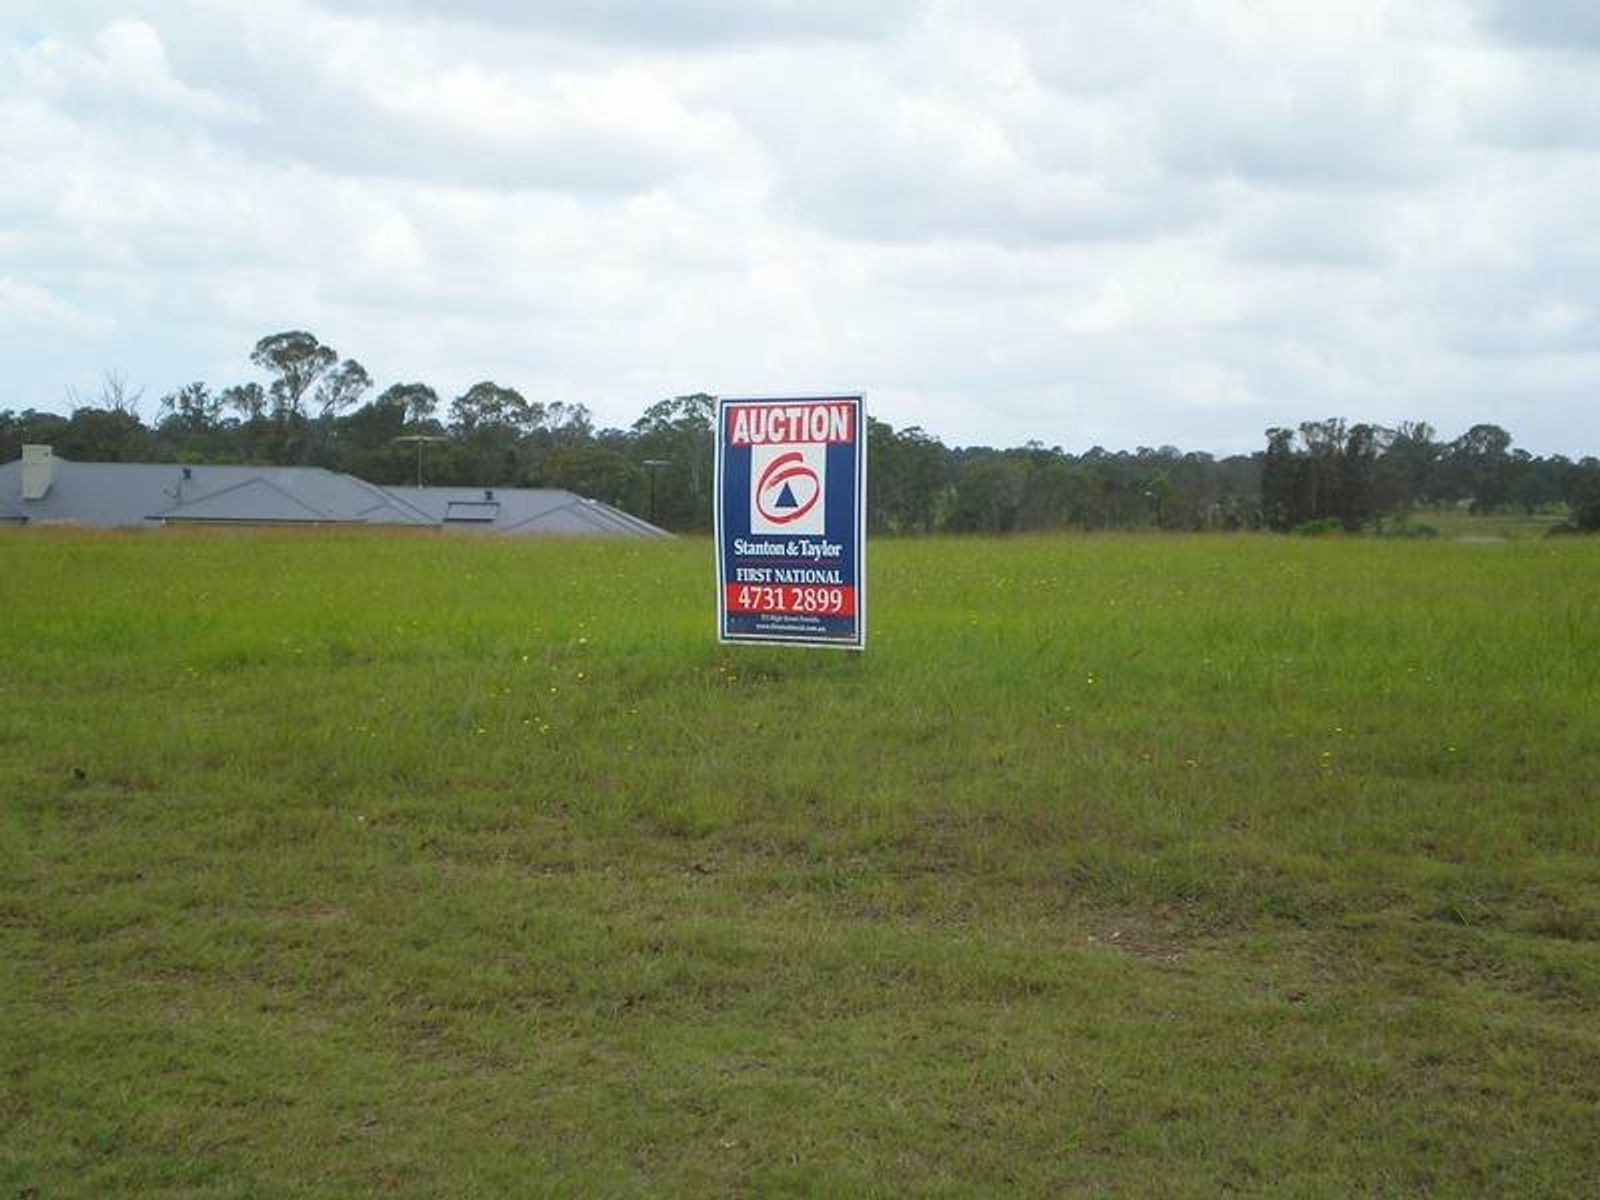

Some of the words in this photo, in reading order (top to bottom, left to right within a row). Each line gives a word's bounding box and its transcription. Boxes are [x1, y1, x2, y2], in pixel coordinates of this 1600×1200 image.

[732, 405, 849, 443] AUCTION
[734, 539, 785, 555] Stanton
[786, 541, 799, 556] &
[799, 540, 842, 561] Taylor
[736, 568, 773, 582] FIRST
[775, 569, 843, 584] NATIONAL
[738, 586, 786, 610] 4731
[791, 588, 842, 612] 2899
